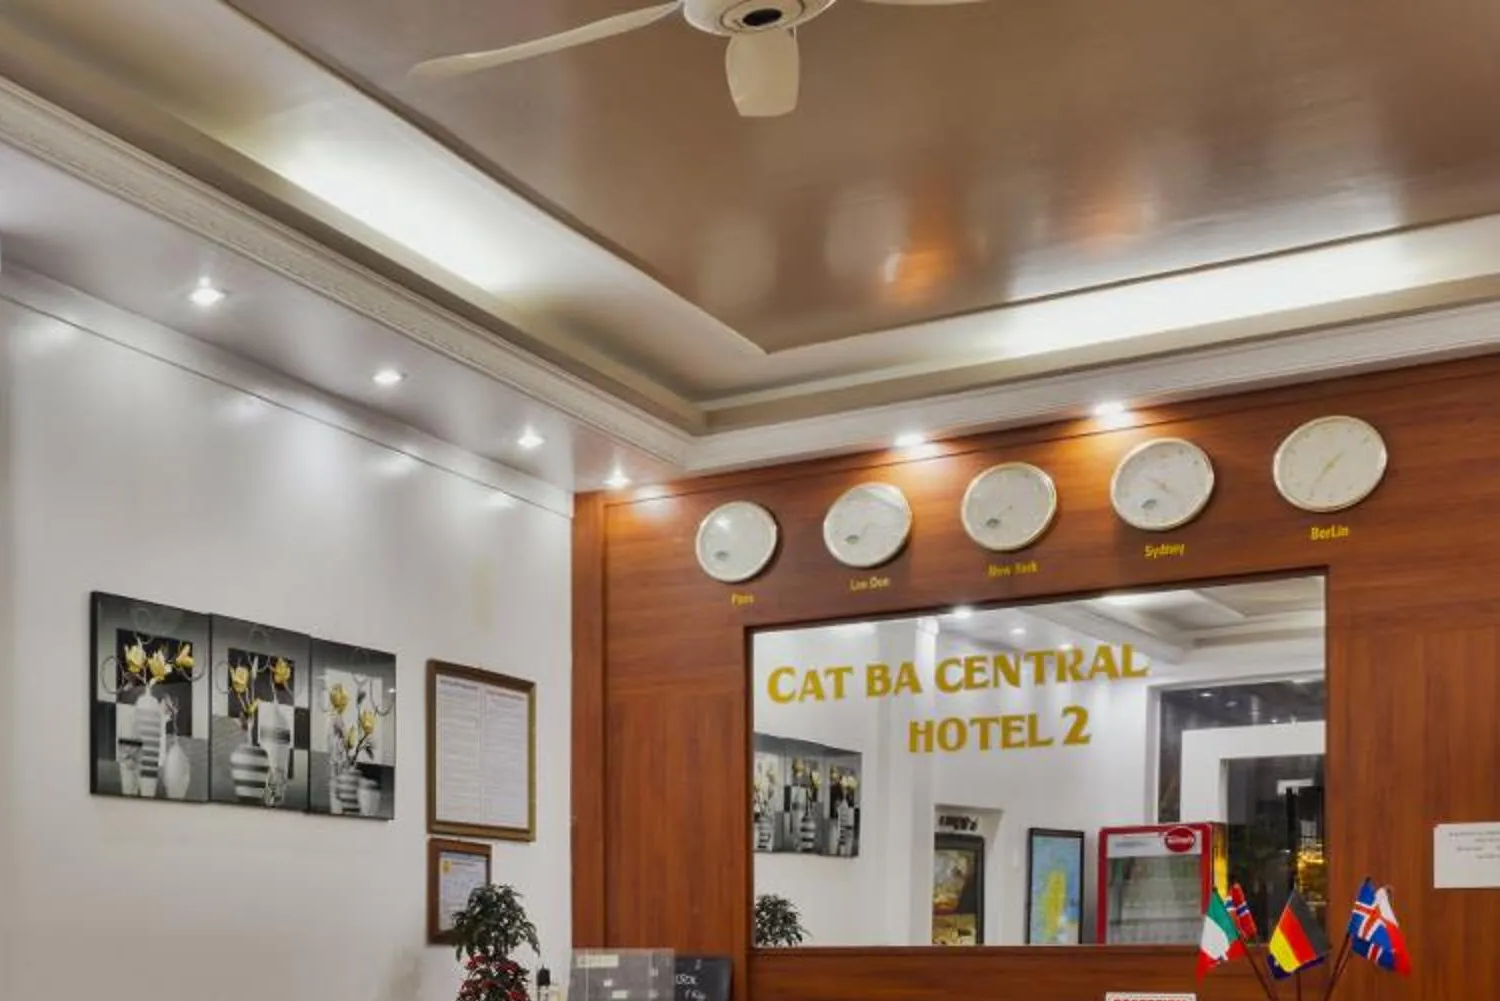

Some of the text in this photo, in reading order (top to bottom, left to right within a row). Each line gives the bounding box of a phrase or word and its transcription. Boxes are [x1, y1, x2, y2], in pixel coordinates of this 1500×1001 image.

[1144, 543, 1185, 559] Sydney
[766, 643, 1149, 705] CAT BA CENTRAL
[907, 705, 1092, 754] HOTEL 2
